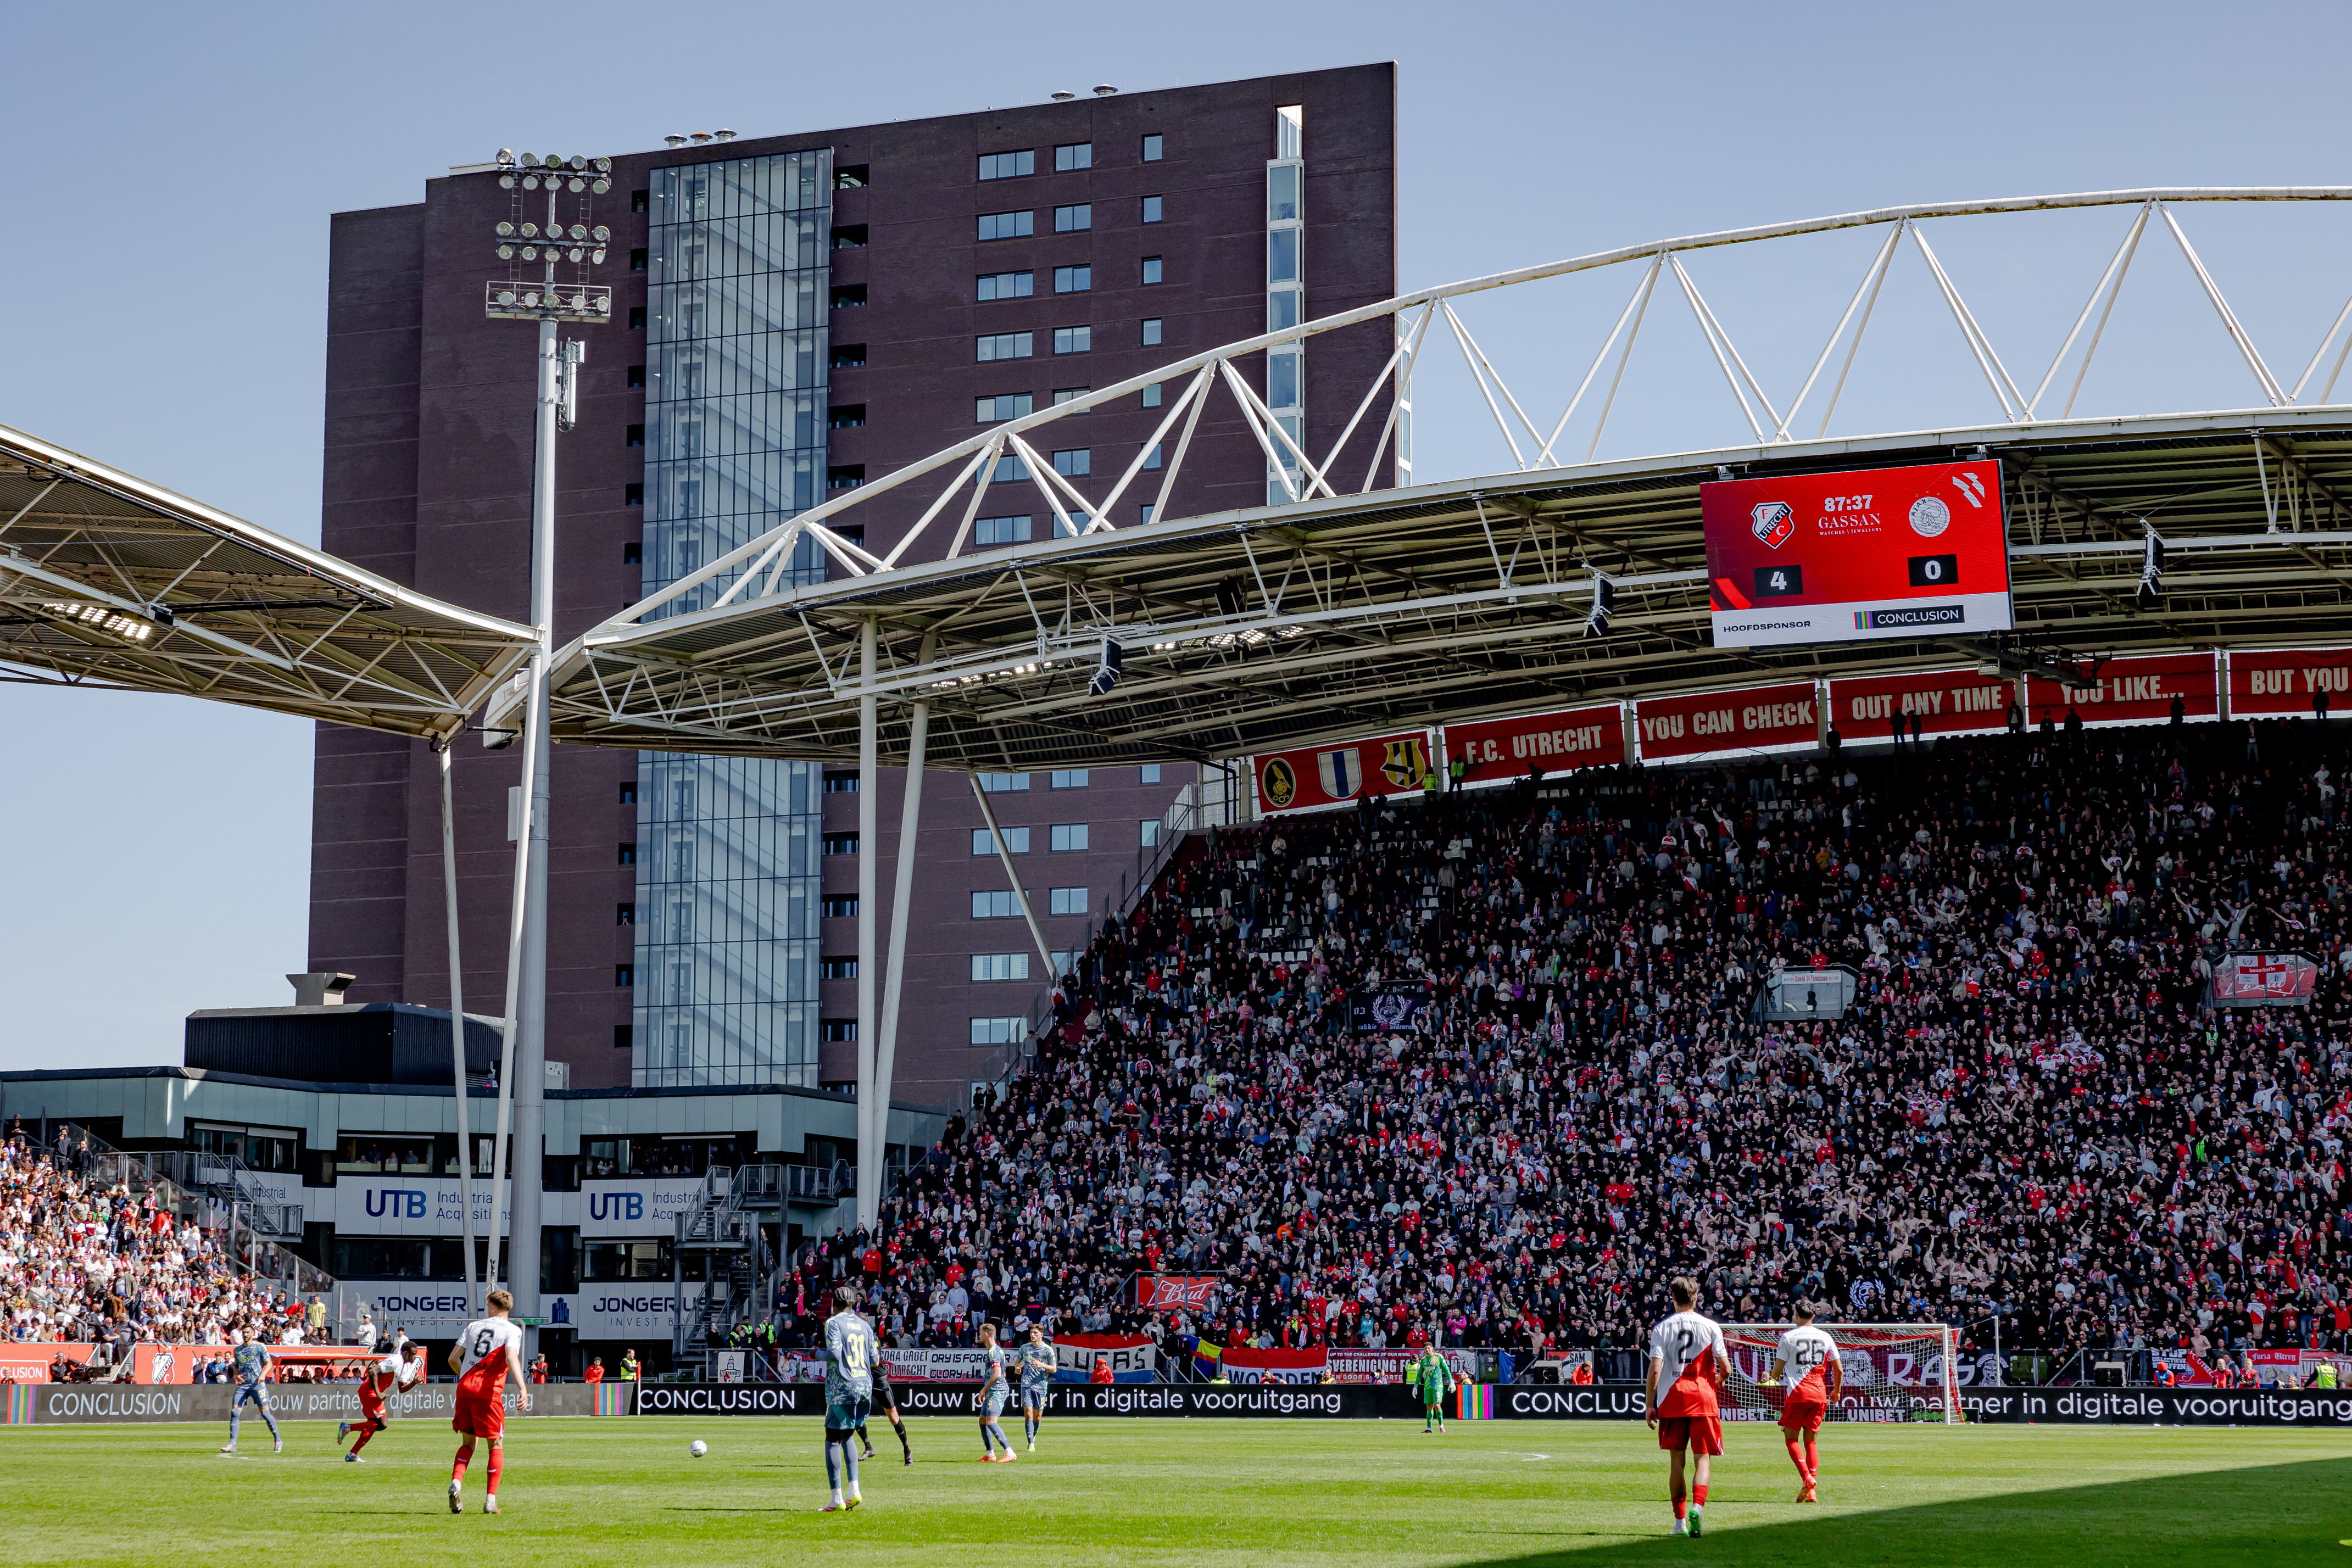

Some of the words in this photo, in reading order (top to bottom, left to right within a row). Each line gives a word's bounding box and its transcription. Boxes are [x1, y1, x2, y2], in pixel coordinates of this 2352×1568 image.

[1824, 494, 1873, 512] 87:37
[1911, 499, 1927, 517] AJAX
[1759, 506, 1788, 539] UTRECHT
[1762, 509, 1768, 520] F
[1818, 513, 1881, 529] GASSAN
[1776, 526, 1785, 537] C
[1924, 560, 1942, 580] 0
[1770, 571, 1787, 590] 4
[1723, 620, 1812, 633] HOOFDSPONSOR
[1877, 610, 1959, 625] CONCLUSION
[2251, 668, 2294, 695] BUT
[2303, 666, 2349, 693] YOU
[2060, 678, 2104, 705] YOU
[2114, 675, 2184, 701] LIKE...
[1852, 693, 1893, 721] OUT
[1902, 690, 1944, 717] ANY
[1951, 685, 2003, 713] TIME
[1642, 715, 1685, 741] YOU
[1693, 708, 1735, 736] CAN
[1743, 700, 1815, 730] CHECK
[1465, 739, 1506, 764] F.C.
[1513, 725, 1603, 759] UTRECHT
[1272, 794, 1290, 803] DOS
[365, 1189, 427, 1218] UTB
[437, 1191, 493, 1203] Indutria
[590, 1192, 643, 1220] UTB
[1161, 1283, 1205, 1302] Bud
[593, 1297, 706, 1312] JONGERUS
[610, 1317, 659, 1326] INVEST
[474, 1329, 494, 1358] 6
[847, 1333, 865, 1368] 31
[1677, 1329, 1693, 1365] 2
[1796, 1339, 1825, 1365] 26
[904, 1350, 929, 1361] GROET
[953, 1354, 961, 1363] IS
[1569, 1353, 1585, 1363] SAM
[2251, 1353, 2271, 1361] Forza
[2274, 1352, 2297, 1361] Utreg
[891, 1364, 927, 1377] UTRECHT
[930, 1369, 963, 1379] GLORY
[258, 1388, 266, 1398] 37
[269, 1393, 304, 1411] ouw
[309, 1391, 362, 1415] partne
[389, 1388, 445, 1414] digitale
[49, 1392, 181, 1416] CONCLUSION
[639, 1390, 795, 1410] CONCLUSION
[901, 1388, 963, 1409] Jouw
[1066, 1387, 1086, 1409] in
[1095, 1388, 1184, 1412] digitale
[1191, 1390, 1341, 1414] vooruitgang
[1512, 1392, 1647, 1413] CONCLUS
[2023, 1393, 2047, 1414] in
[2056, 1392, 2164, 1419] digitale
[2172, 1394, 2352, 1421] vooruitgang
[1847, 1408, 1905, 1422] UNIBET
